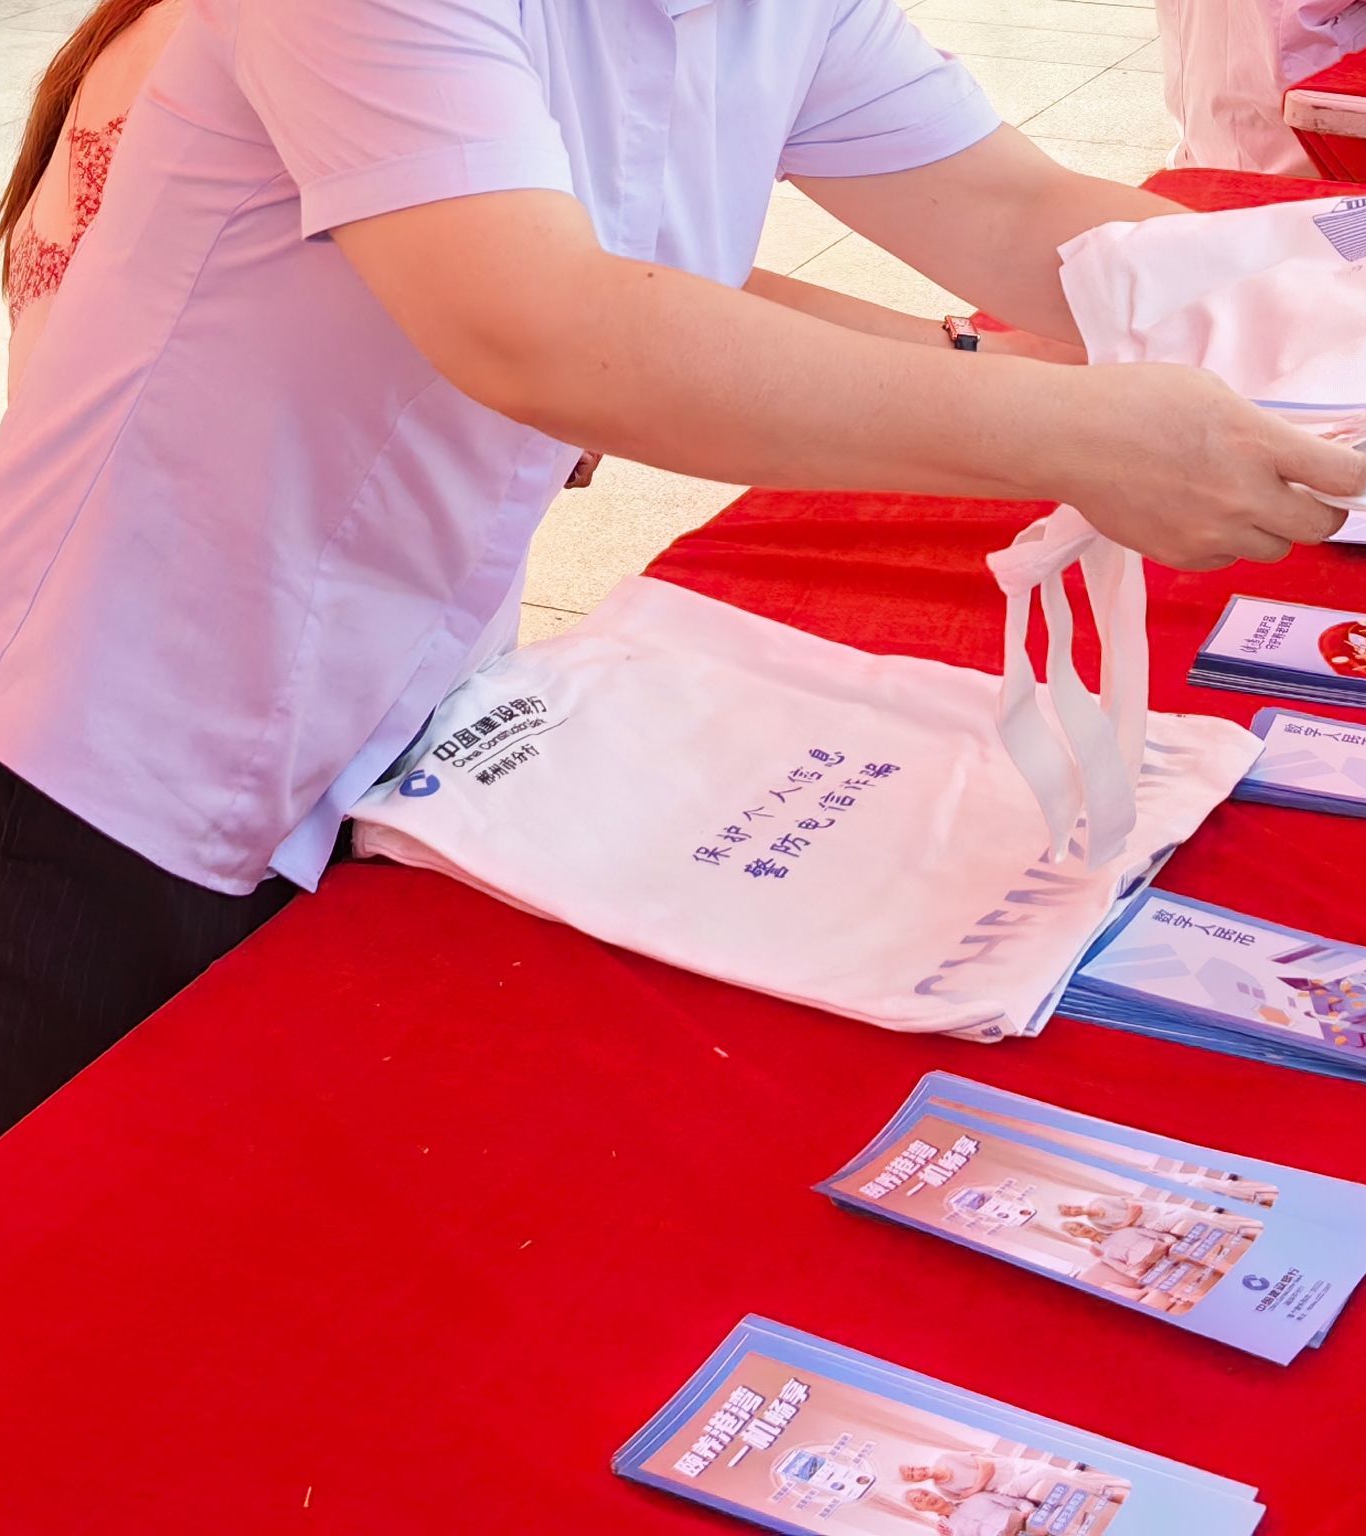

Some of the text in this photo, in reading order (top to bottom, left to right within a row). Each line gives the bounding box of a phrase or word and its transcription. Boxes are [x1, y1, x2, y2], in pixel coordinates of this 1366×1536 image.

[432, 695, 547, 762] 中国建设银行
[475, 743, 541, 787] 郴州市分行
[692, 748, 846, 866] 保护个人信息
[743, 762, 901, 879] 警防电信诈骗
[1151, 908, 1256, 947] 数字人民币
[673, 1385, 766, 1479] 颐养港湾
[727, 1377, 812, 1468] 一机畅享
